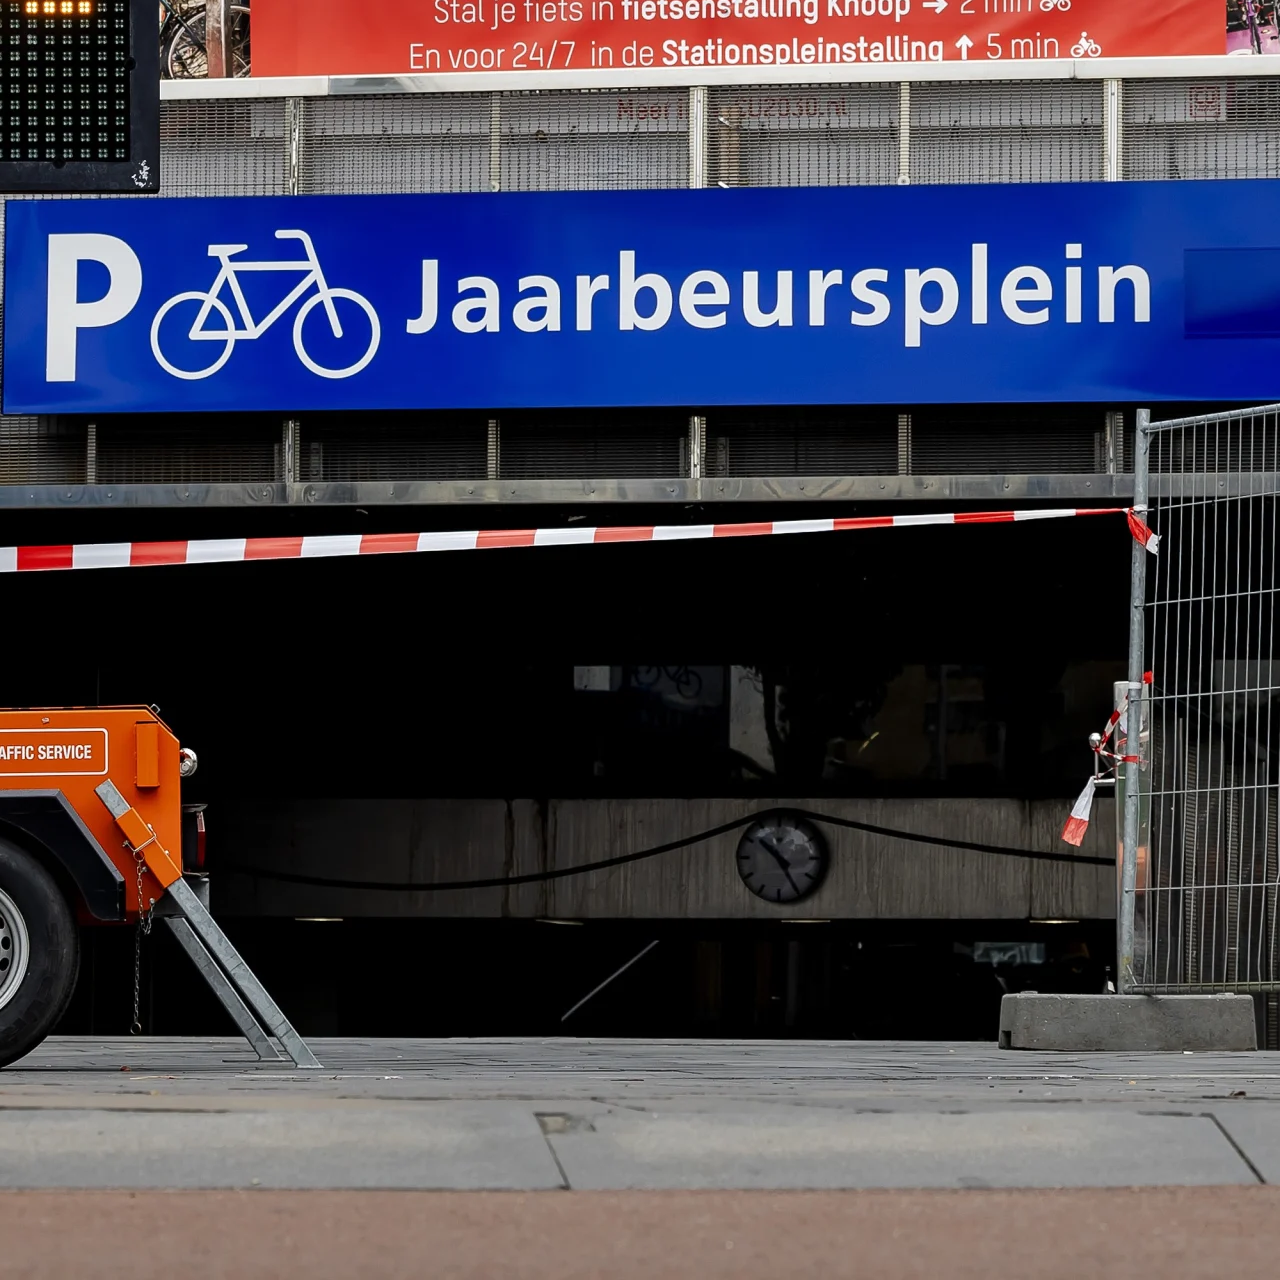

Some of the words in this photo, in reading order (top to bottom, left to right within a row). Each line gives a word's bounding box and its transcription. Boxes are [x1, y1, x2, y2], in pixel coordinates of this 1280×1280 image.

[410, 44, 440, 69] En
[449, 48, 506, 69] voor
[513, 40, 576, 68] 24/7
[591, 41, 613, 66] in
[622, 40, 654, 66] de
[662, 36, 943, 66] Stationspleinstalling
[986, 33, 1002, 59] 5
[1011, 32, 1059, 58] min
[46, 233, 142, 382] P
[407, 244, 1150, 347] Jaarbeursplein
[37, 745, 91, 760] SERVICE
